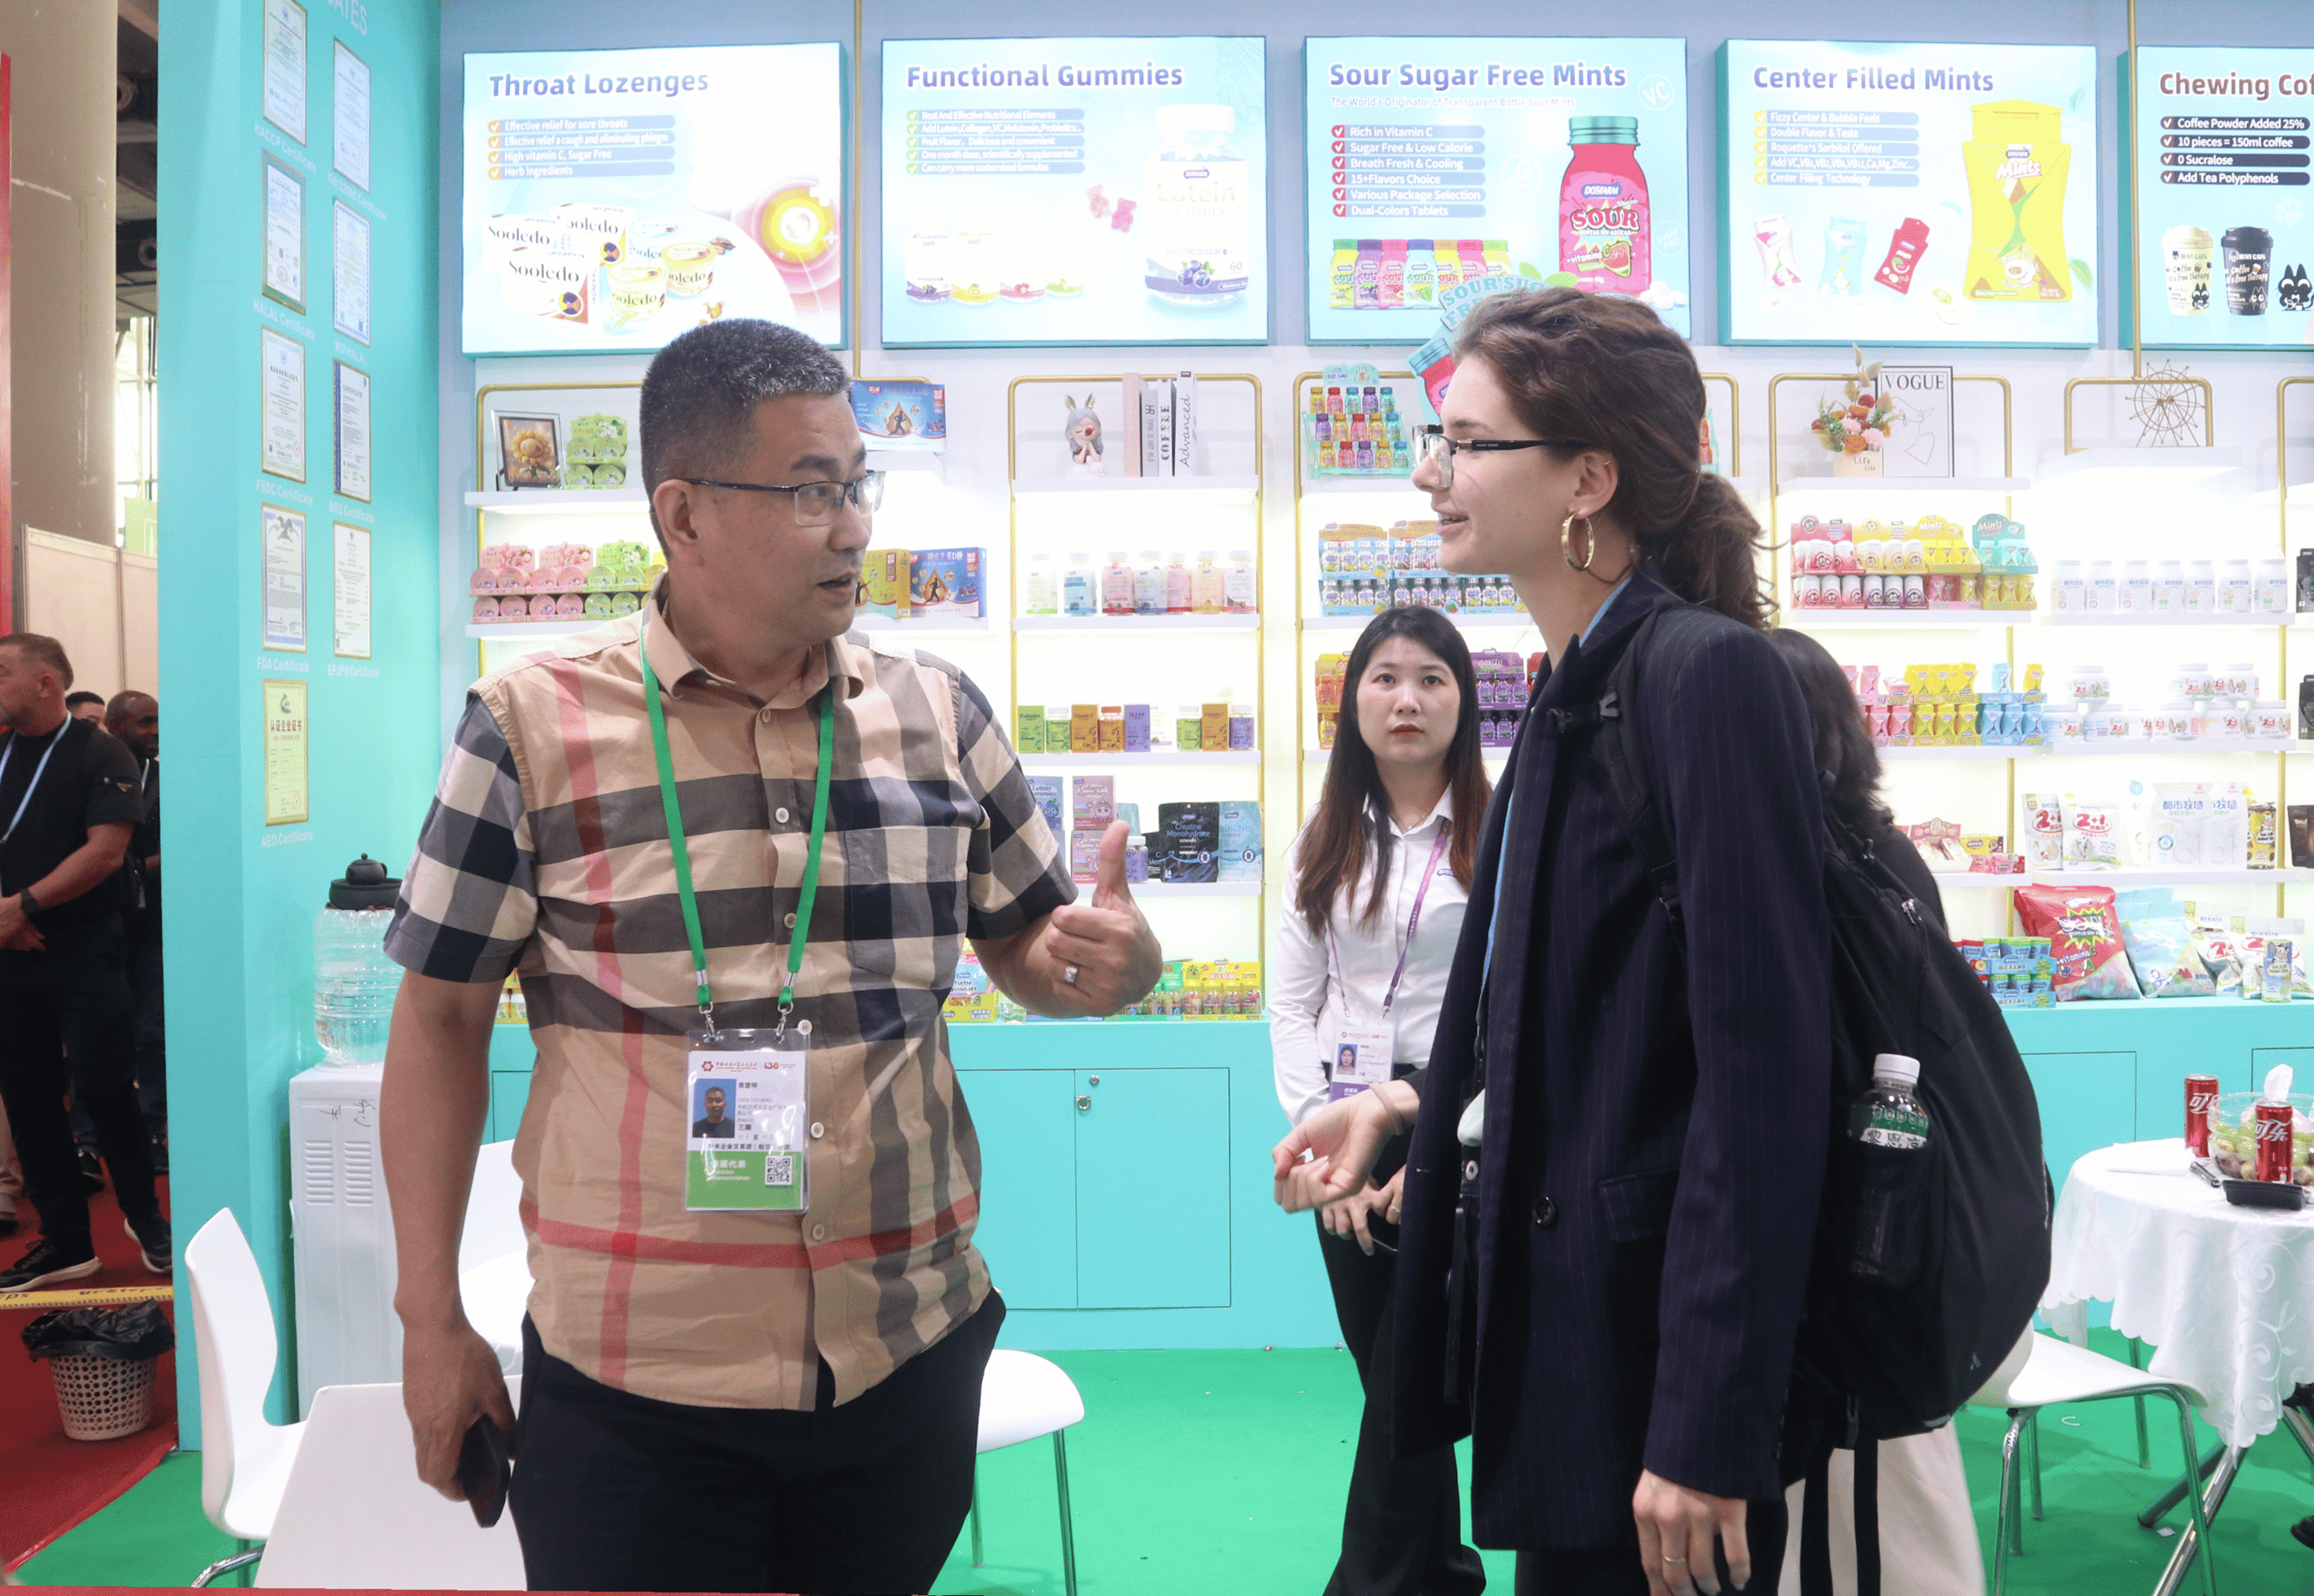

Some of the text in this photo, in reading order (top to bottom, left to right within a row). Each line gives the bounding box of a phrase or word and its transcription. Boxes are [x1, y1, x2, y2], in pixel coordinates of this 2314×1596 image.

[907, 62, 1183, 87] Functional Gummies
[1330, 62, 1626, 91] Sour Sugar Free Mints
[1754, 66, 1994, 91] Center Filled Mints
[489, 74, 708, 97] Throat Lozenges
[2159, 71, 2270, 101] Chewing
[1643, 82, 1670, 105] VC
[1331, 98, 1575, 108] The World's Originator of Transparent Bottle Sour Mints
[1770, 112, 1881, 124] Fizzy Center & Bubble Feels
[2178, 118, 2305, 130] Coffee Powder Added 25%
[505, 119, 628, 131] Effective relief for sore throats
[1350, 126, 1433, 137] Rich in Vitamin C
[1770, 127, 1859, 138] Double Flavor & Taste
[505, 136, 536, 146] Effective
[537, 135, 555, 145] relief
[561, 135, 583, 147] cough
[584, 134, 598, 144] and
[599, 133, 640, 145] eliminating
[640, 133, 669, 145] phlegm
[2178, 136, 2190, 147] 10
[2192, 136, 2222, 148] pieces
[2231, 137, 2262, 147] 150ml
[2263, 137, 2293, 147] coffee
[1350, 142, 1474, 155] Sugar Free & Low Calorie
[1770, 142, 1883, 155] Roquette's Sorbitol Offered
[505, 150, 612, 163] High vitamin C, Sugar Free
[1770, 158, 1786, 167] Add
[2178, 155, 2234, 165] 0 Sucralose
[1350, 158, 1464, 171] Breath Fresh & Cooling
[1996, 160, 2040, 179] Mints
[505, 165, 573, 178] Herb Ingredients
[1350, 174, 1440, 184] 15+Flavors Choice
[1770, 173, 1871, 186] Center Filling Technology
[2178, 172, 2279, 185] Add Tea Polyphenols
[1157, 182, 1235, 202] Lutein
[1350, 189, 1481, 202] Various Package Selection
[1584, 185, 1619, 196] DOSFARM
[1351, 205, 1449, 216] Dual-Colors Tablets
[1572, 208, 1640, 231] SOUR
[488, 226, 550, 245] Sooledo
[509, 260, 578, 283] Sooledo
[1229, 260, 1243, 271] 60
[1443, 278, 1497, 306] SOUR
[1883, 374, 1945, 390] VOGUE
[1160, 405, 1169, 460] COFFEE
[1179, 394, 1191, 468] Advanced
[1854, 456, 1871, 465] Life
[1918, 521, 1945, 531] Mints
[1977, 521, 2003, 532] Mints
[2162, 799, 2203, 810] 都市牧场
[2077, 813, 2106, 827] 2+1
[1174, 823, 1202, 831] Creatine
[1166, 830, 1210, 839] Monohydrate
